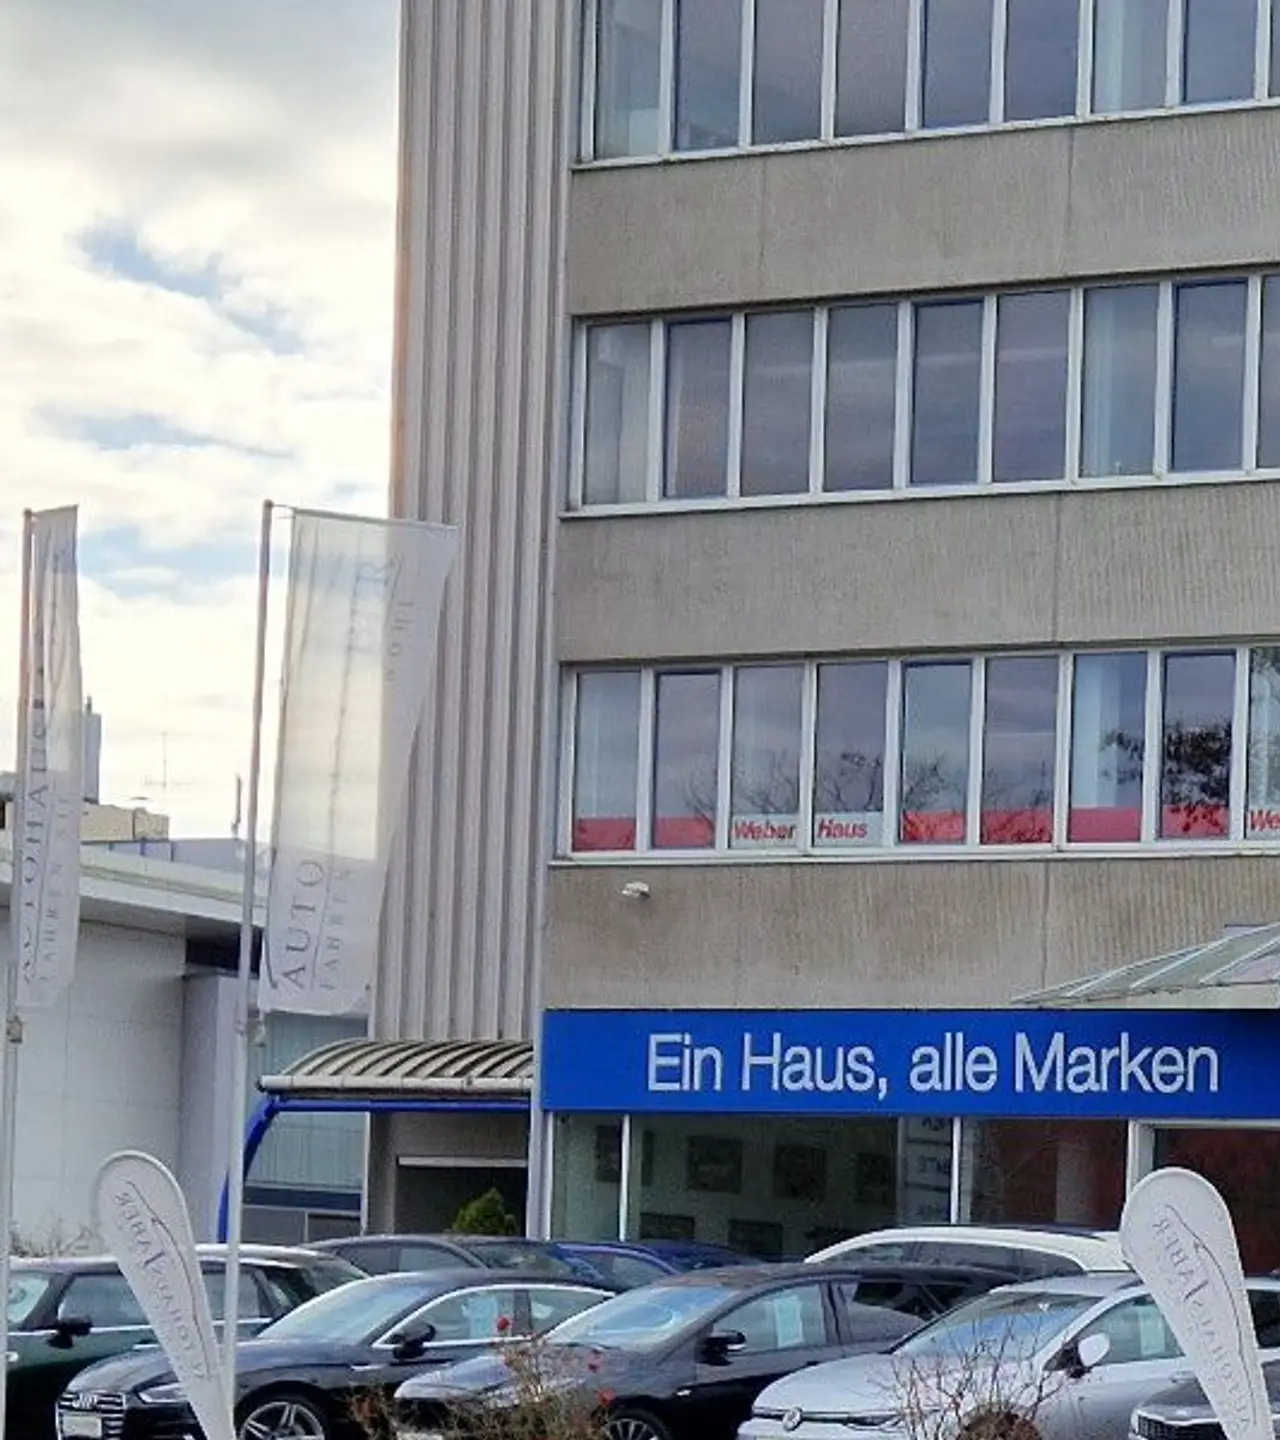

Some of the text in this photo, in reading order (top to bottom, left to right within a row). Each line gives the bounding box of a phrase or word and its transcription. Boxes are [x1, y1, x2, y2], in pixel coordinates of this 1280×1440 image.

[733, 817, 868, 841] Weber Haus
[647, 1031, 1218, 1100] Ein Haus, alle Marken
